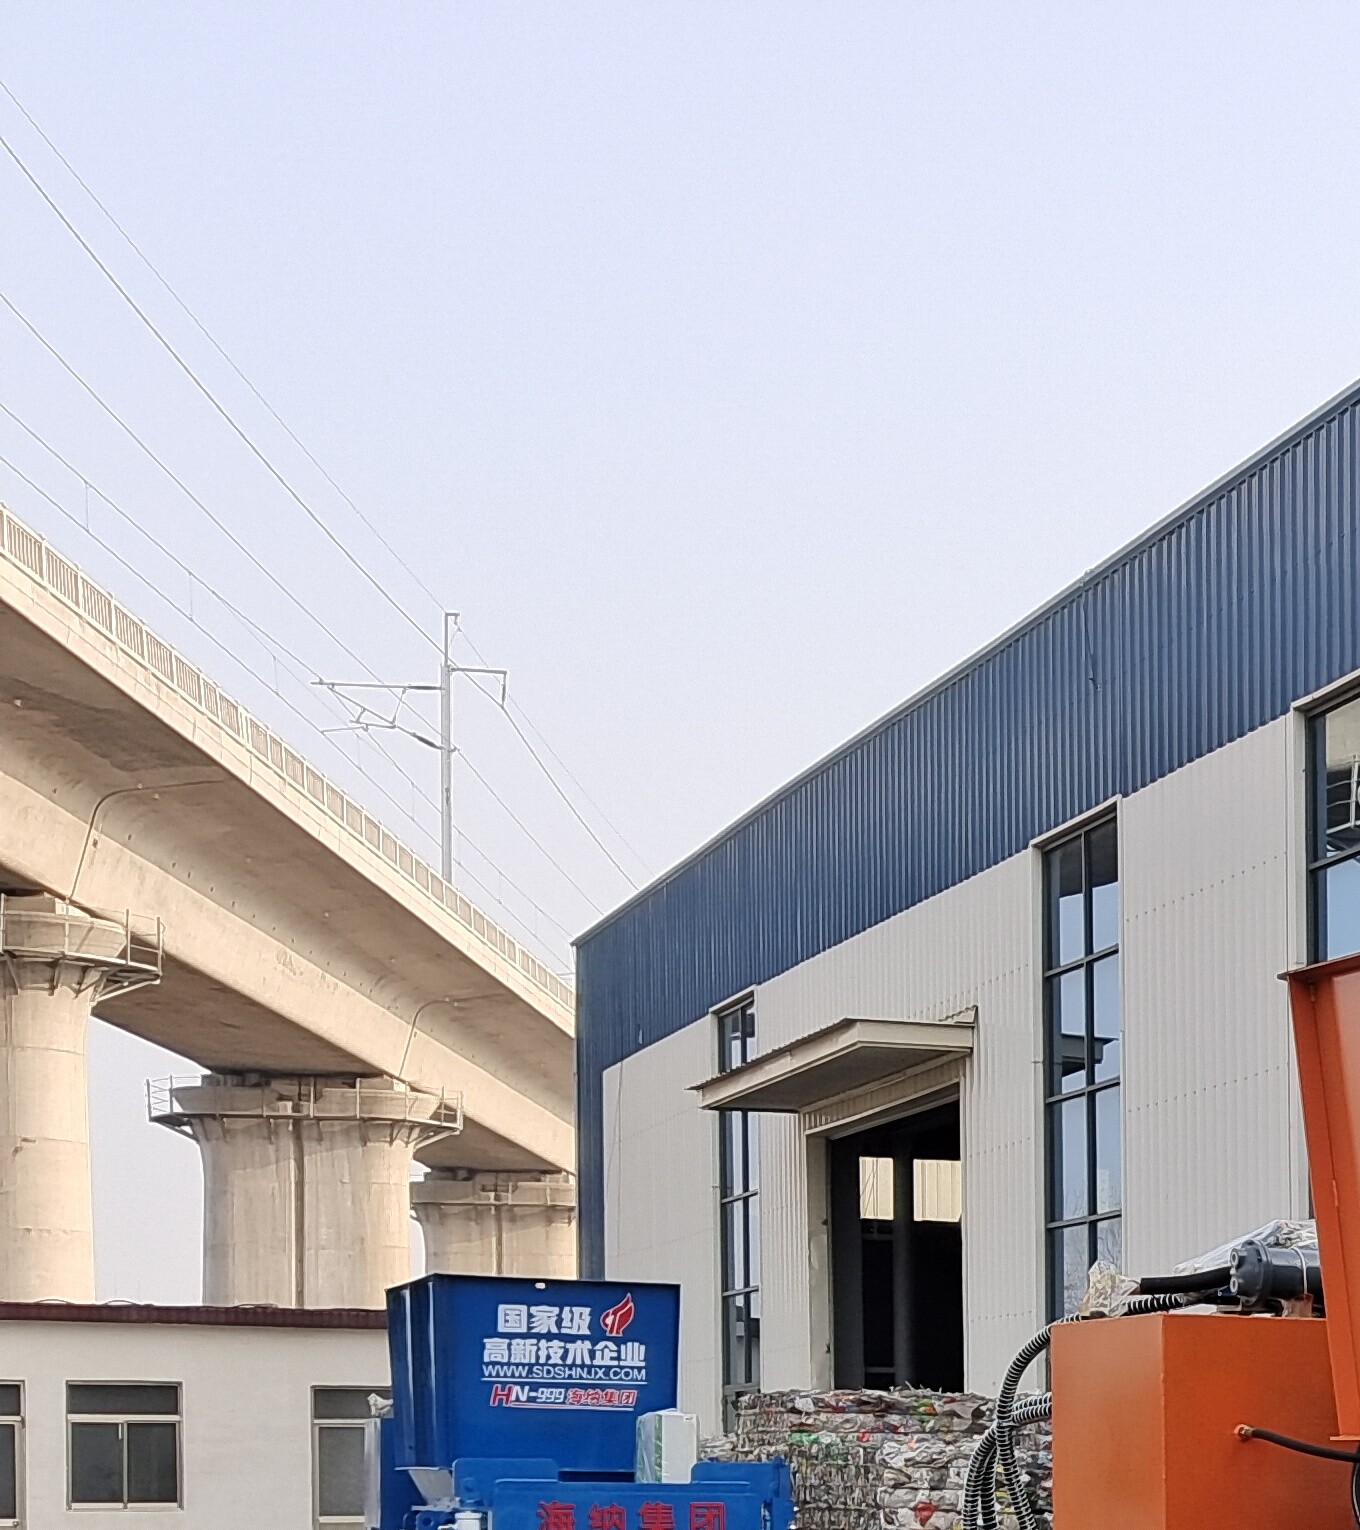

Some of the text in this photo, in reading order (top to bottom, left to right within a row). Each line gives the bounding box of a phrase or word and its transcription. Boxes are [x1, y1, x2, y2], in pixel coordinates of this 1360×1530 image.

[497, 1303, 592, 1336] 国家级
[482, 1337, 647, 1367] 高新技术企业
[482, 1364, 647, 1381] WWW.SDSHNJX.COM
[489, 1383, 566, 1407] HN-999
